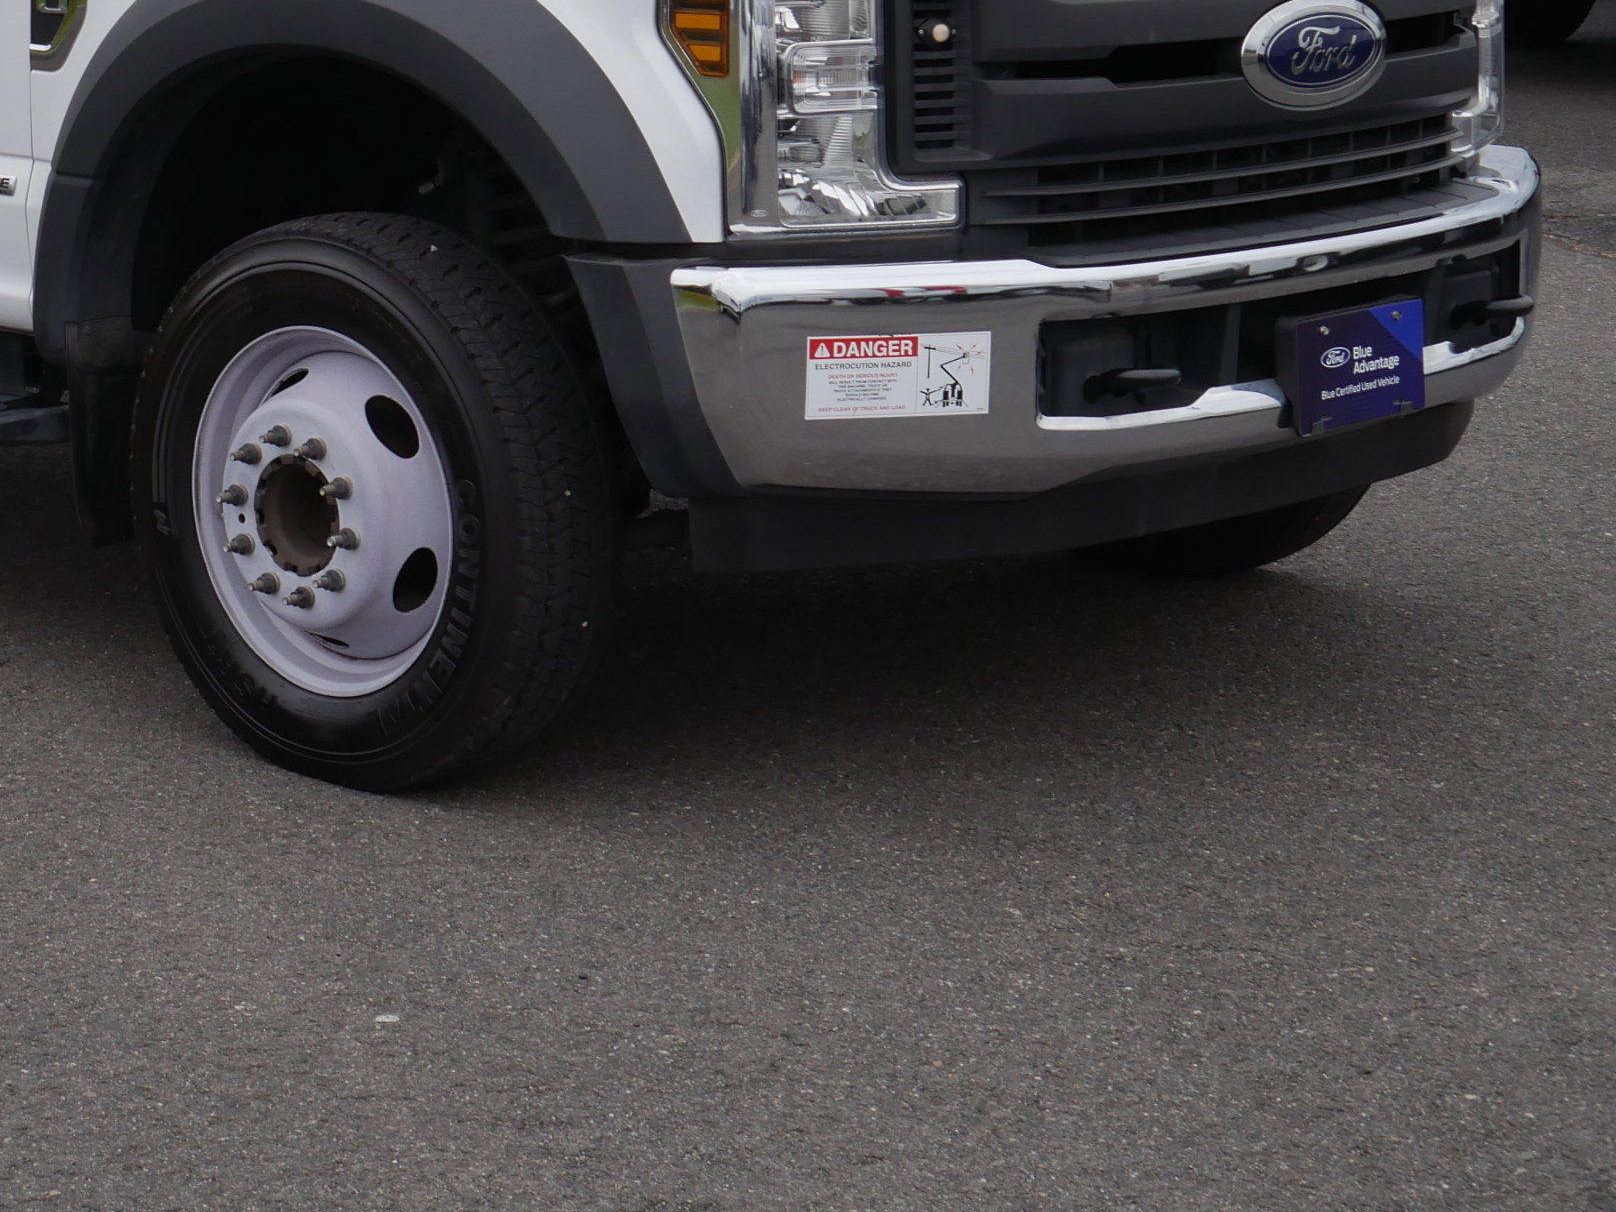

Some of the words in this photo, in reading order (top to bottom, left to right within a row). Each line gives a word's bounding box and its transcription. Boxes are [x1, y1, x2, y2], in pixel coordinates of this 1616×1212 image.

[1290, 25, 1358, 76] Ford
[833, 340, 913, 357] DANGER
[1353, 346, 1372, 360] Blue
[815, 362, 880, 370] ELECTROCUTION
[881, 360, 913, 368] HAZARD
[1353, 355, 1400, 375] Advantage
[1321, 390, 1335, 400] Blue
[1335, 383, 1361, 397] Certified
[1361, 379, 1376, 390] Used
[1378, 375, 1400, 387] Vehicle
